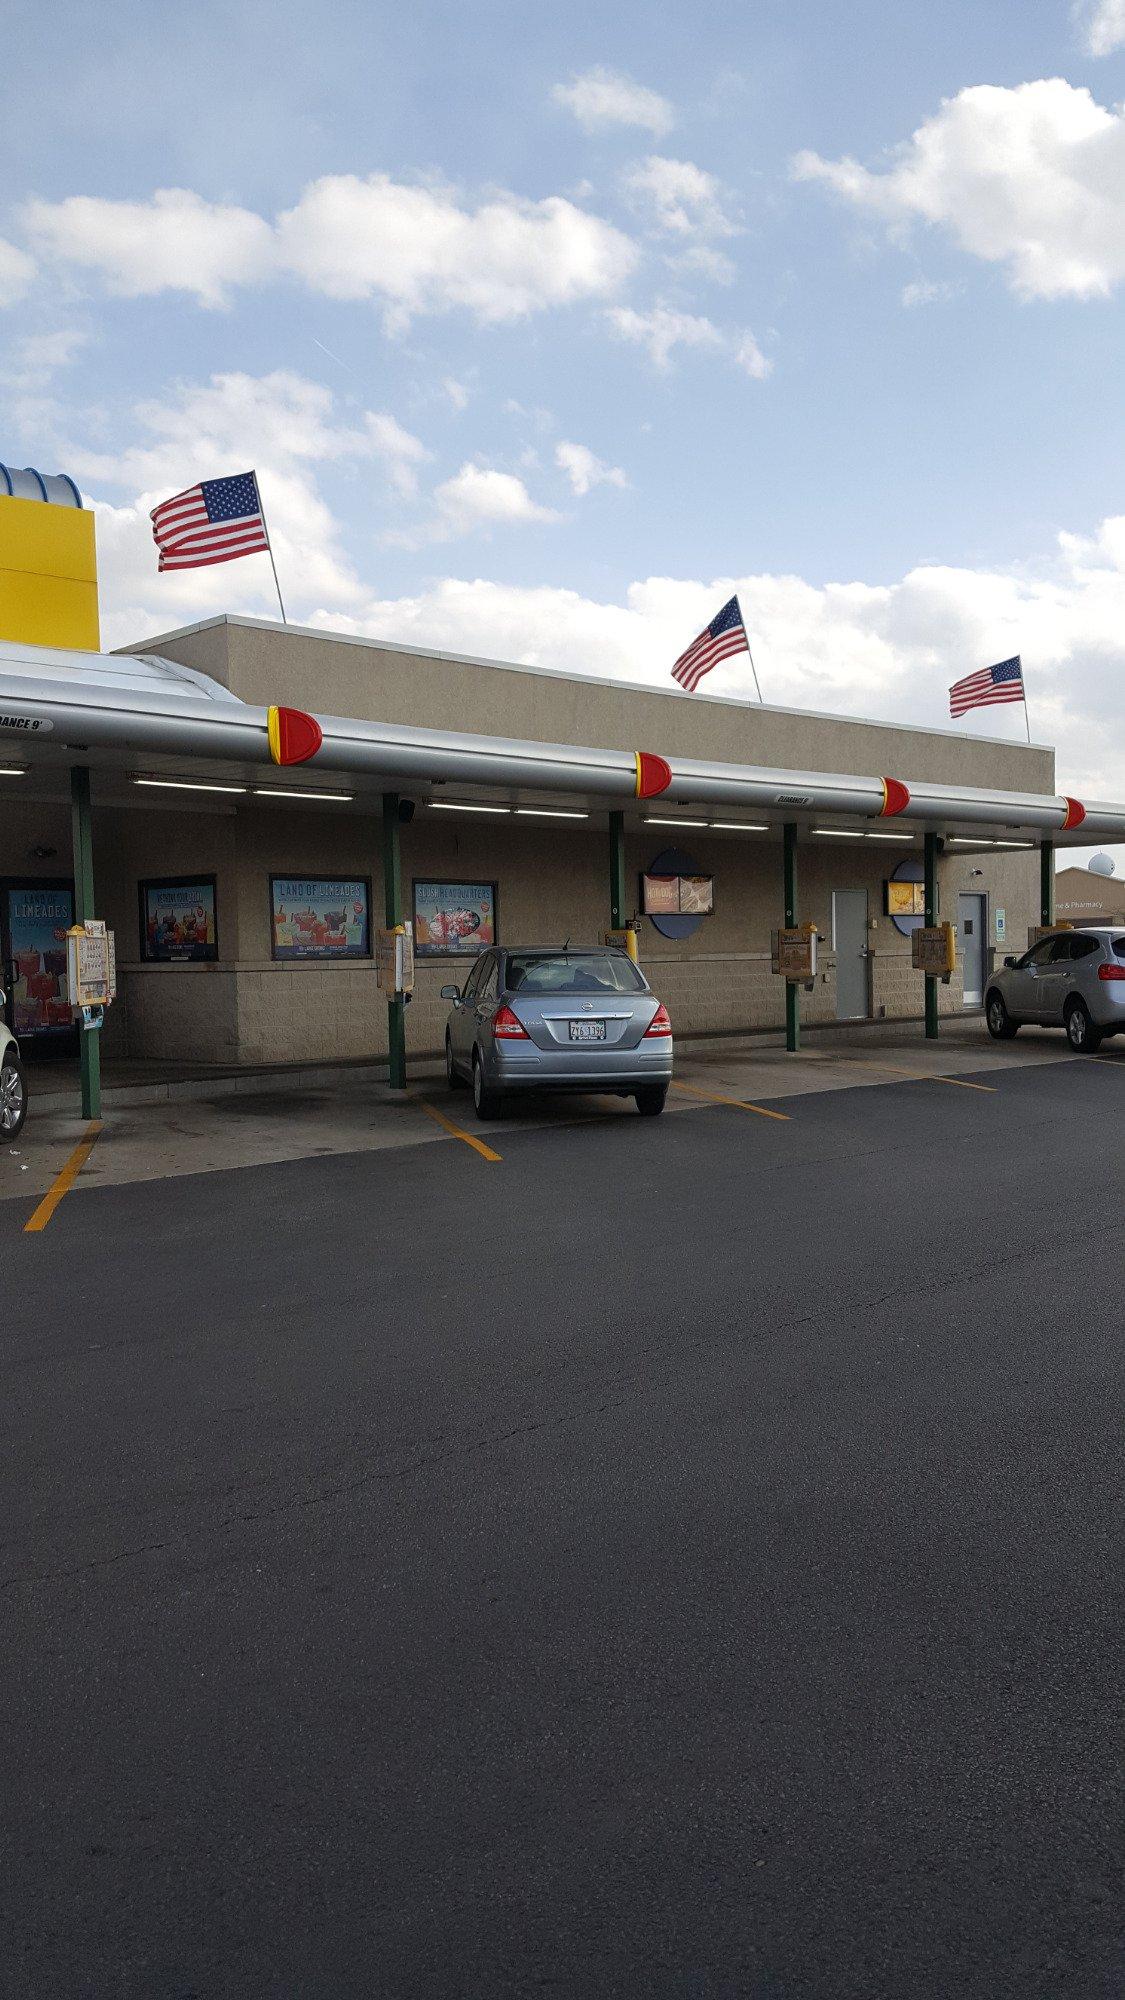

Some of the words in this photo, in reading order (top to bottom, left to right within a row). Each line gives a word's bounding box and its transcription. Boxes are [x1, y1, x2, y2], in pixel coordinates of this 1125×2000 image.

[32, 720, 43, 730] 9'
[280, 883, 303, 896] LAND
[307, 884, 317, 896] OF
[419, 887, 438, 898] SLUSH
[1070, 901, 1103, 909] Pharmacy
